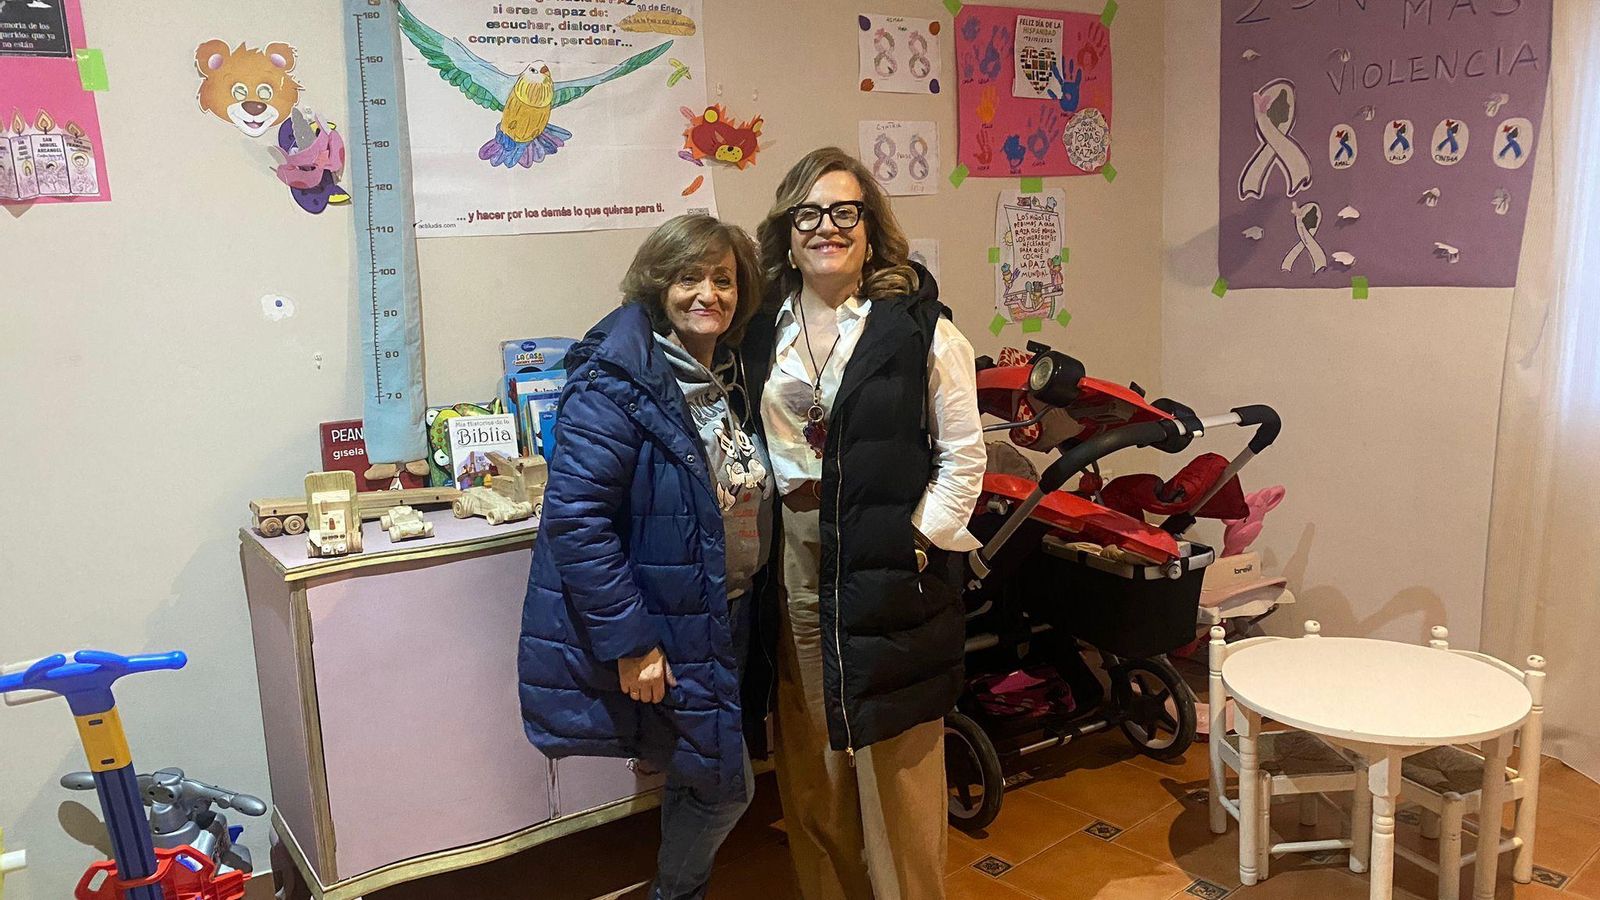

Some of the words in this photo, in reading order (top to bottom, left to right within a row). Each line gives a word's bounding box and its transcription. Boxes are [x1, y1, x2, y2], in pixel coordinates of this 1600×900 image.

[493, 4, 502, 14] si
[506, 6, 538, 15] eres
[545, 8, 586, 18] capaz
[589, 7, 608, 17] de:
[637, 4, 647, 12] 30
[648, 3, 659, 11] de
[660, 4, 682, 15] Enero
[486, 20, 555, 31] escuchar,
[558, 21, 616, 33] dialogar,
[1019, 18, 1035, 26] FELIZ
[468, 34, 558, 46] comprender,
[561, 36, 632, 47] perdonar...
[1326, 40, 1539, 95] VIOLENCIA
[1074, 131, 1101, 143] TODAS
[476, 210, 505, 220] hacer
[507, 210, 522, 222] por
[524, 208, 539, 218] los
[541, 207, 572, 217] demás
[574, 206, 583, 215] lo
[584, 207, 601, 217] que
[603, 205, 633, 216] quieras
[635, 205, 655, 216] para
[1016, 212, 1029, 221] LOS
[1028, 260, 1045, 270] PAZ
[331, 427, 364, 443] PEAN
[456, 427, 511, 446] Biblia
[332, 447, 364, 460] gisela
